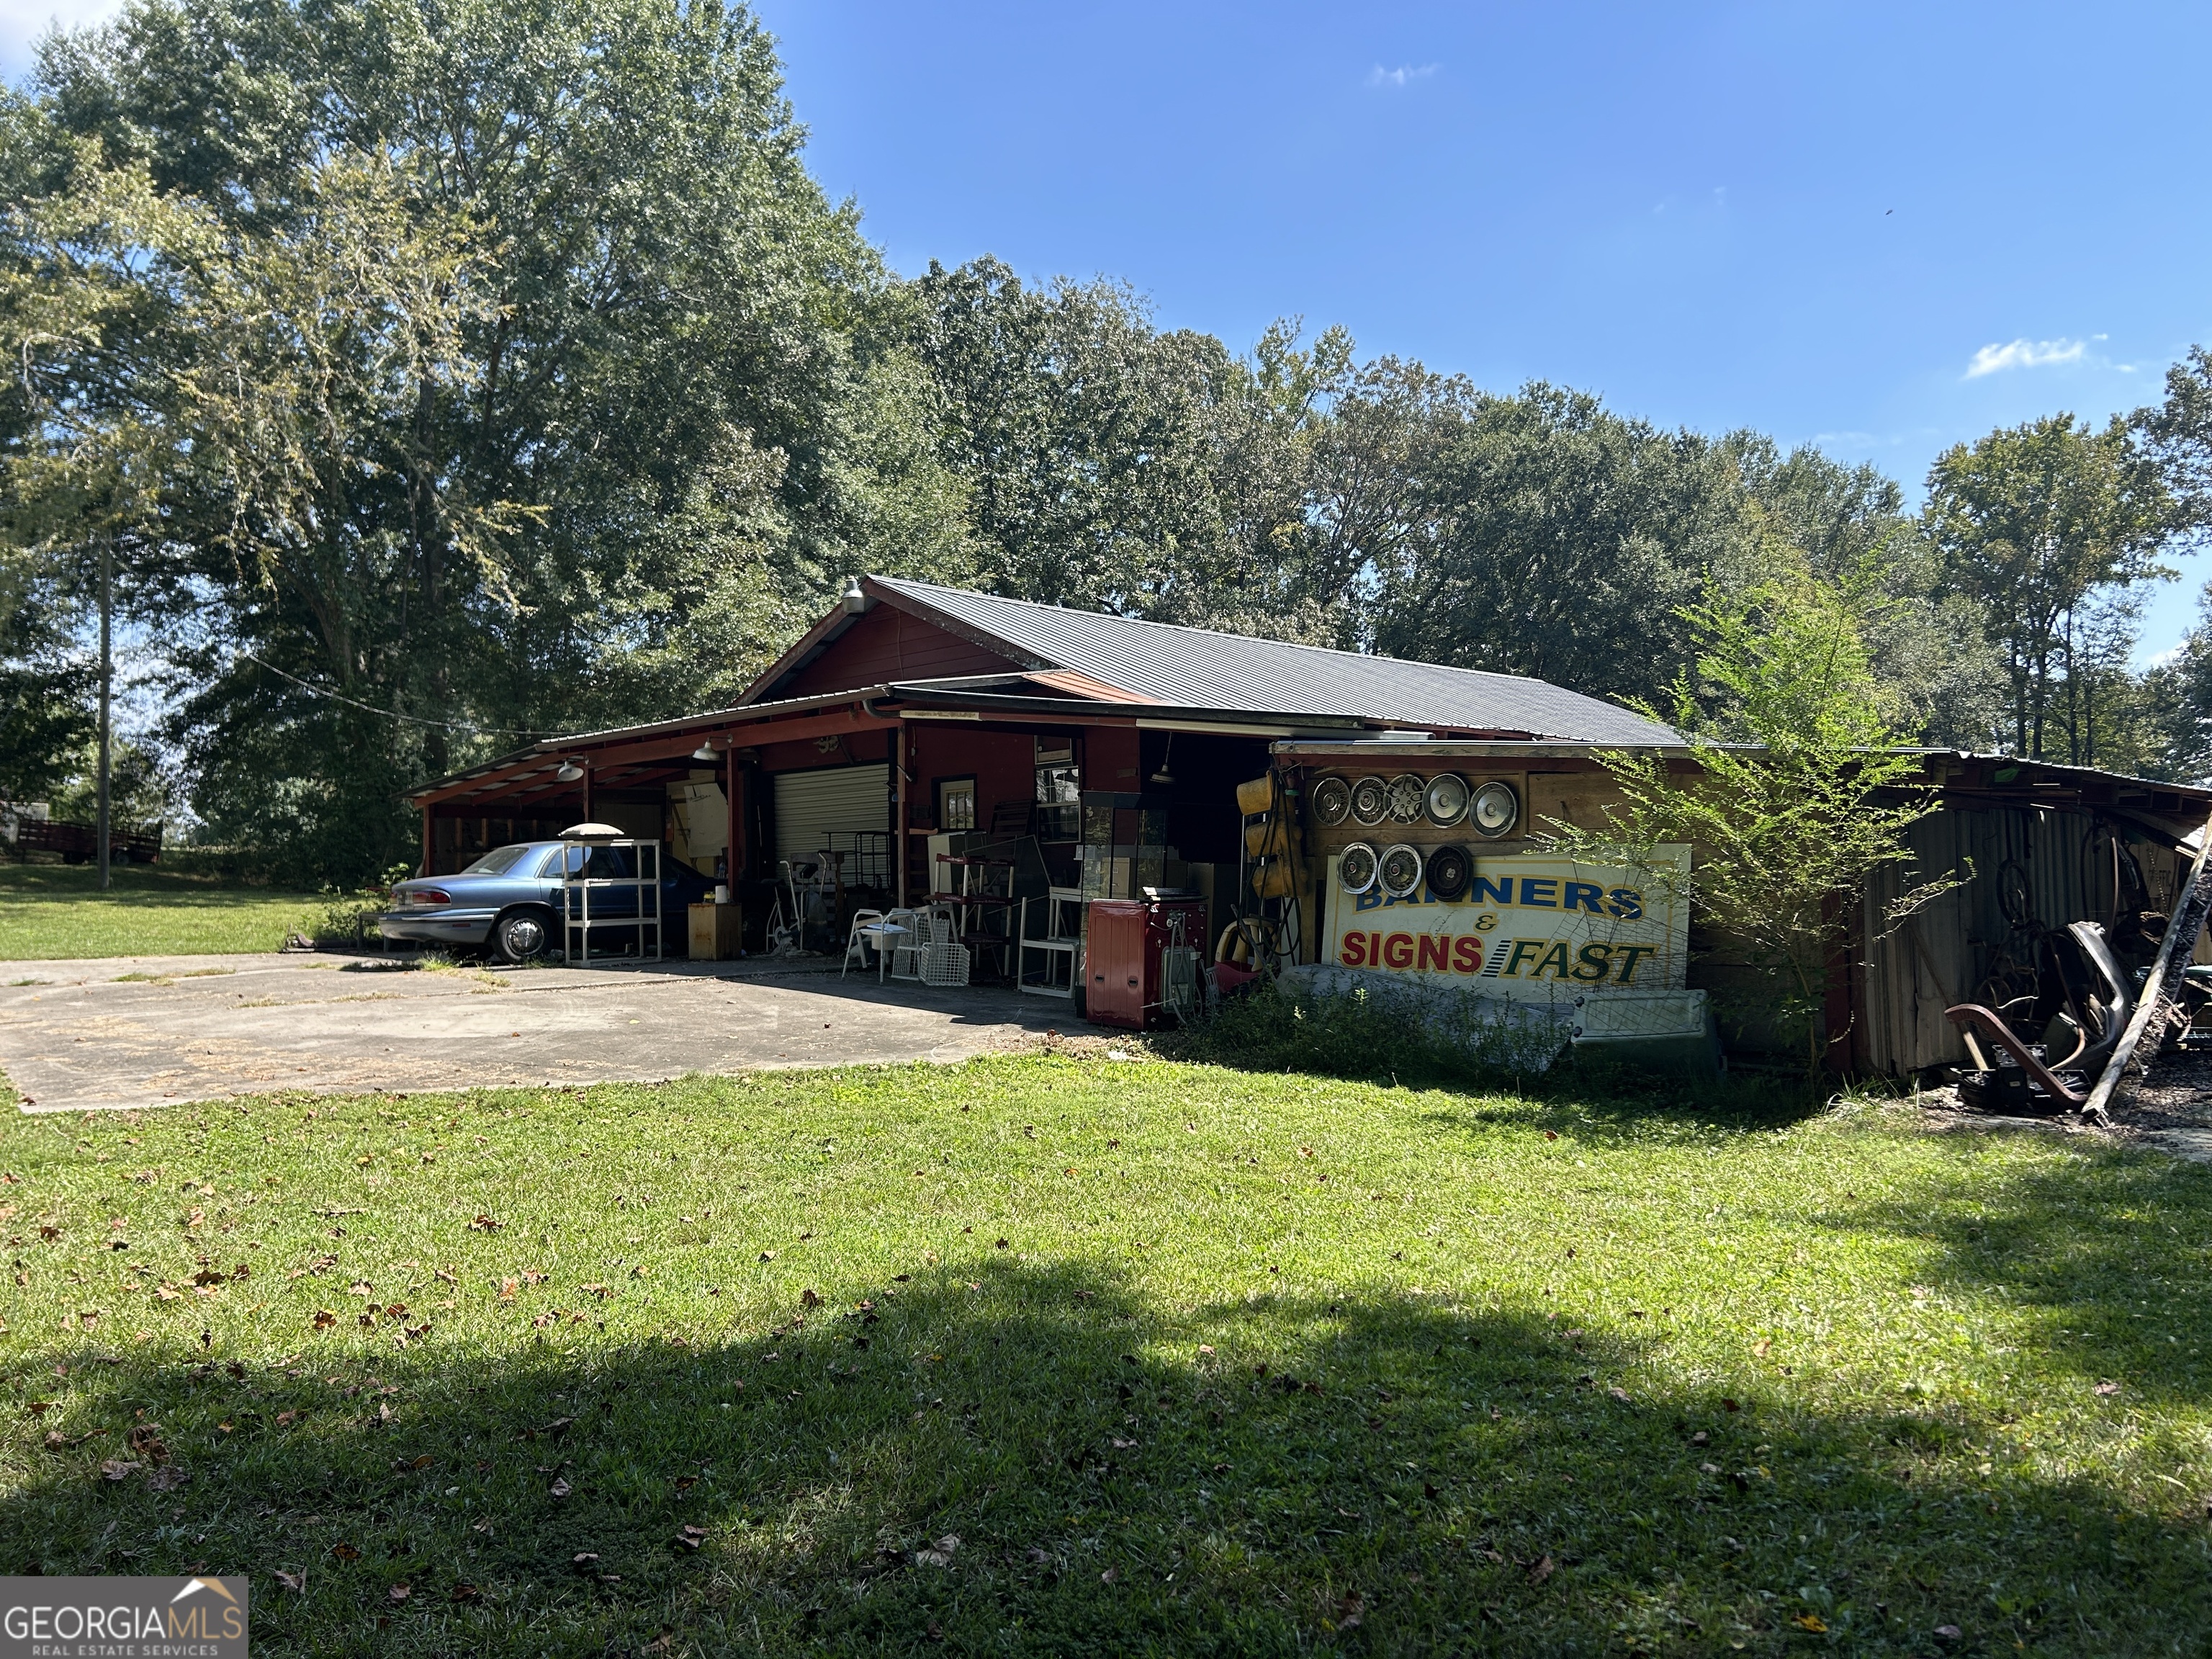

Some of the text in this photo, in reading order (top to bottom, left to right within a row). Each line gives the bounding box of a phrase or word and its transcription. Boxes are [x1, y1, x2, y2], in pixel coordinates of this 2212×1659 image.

[1357, 876, 1642, 920] BNERS
[1475, 915, 1496, 930] &
[1341, 932, 1655, 982] SIGNS FAST
